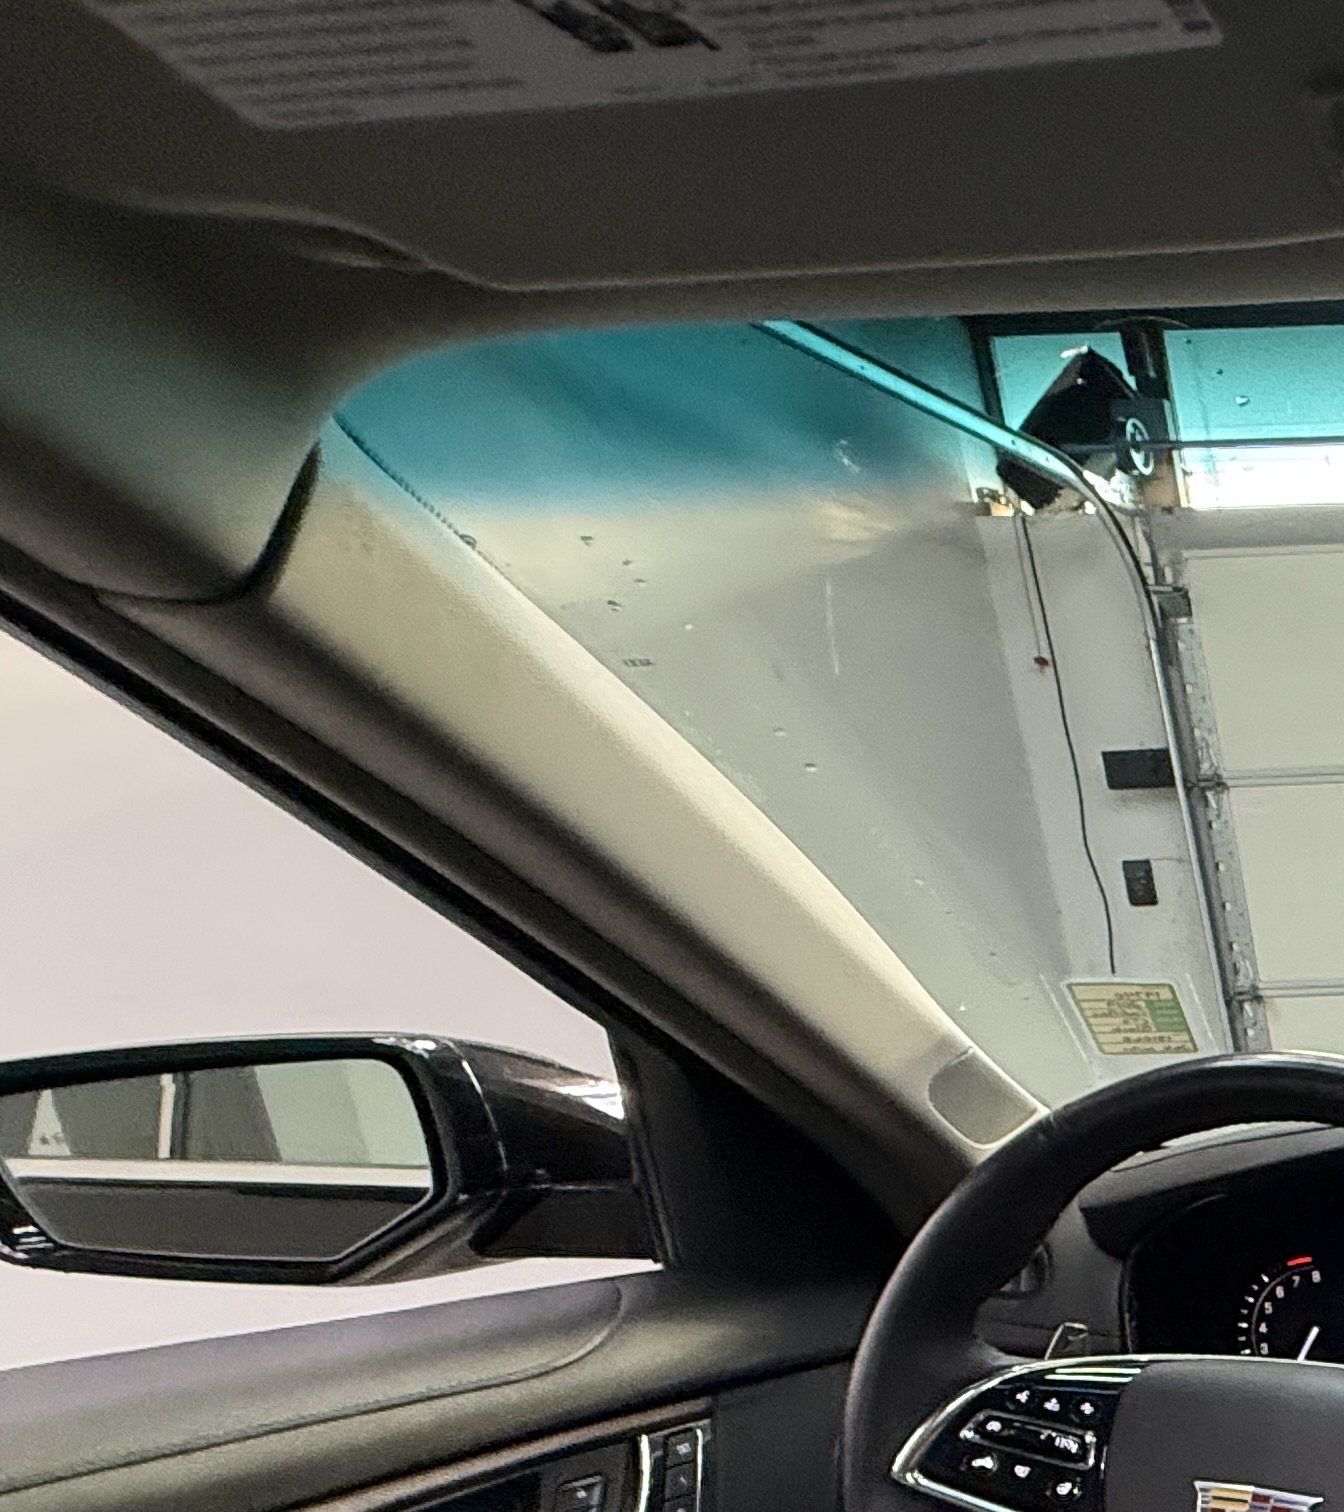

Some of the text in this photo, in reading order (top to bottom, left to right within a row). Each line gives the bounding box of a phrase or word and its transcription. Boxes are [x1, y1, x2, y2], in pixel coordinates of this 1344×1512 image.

[1292, 1275, 1301, 1288] 7
[1311, 1270, 1321, 1283] 8
[1275, 1285, 1285, 1299] 6
[1264, 1301, 1273, 1314] 5
[1258, 1322, 1268, 1334] 4
[1259, 1342, 1269, 1355] 3
